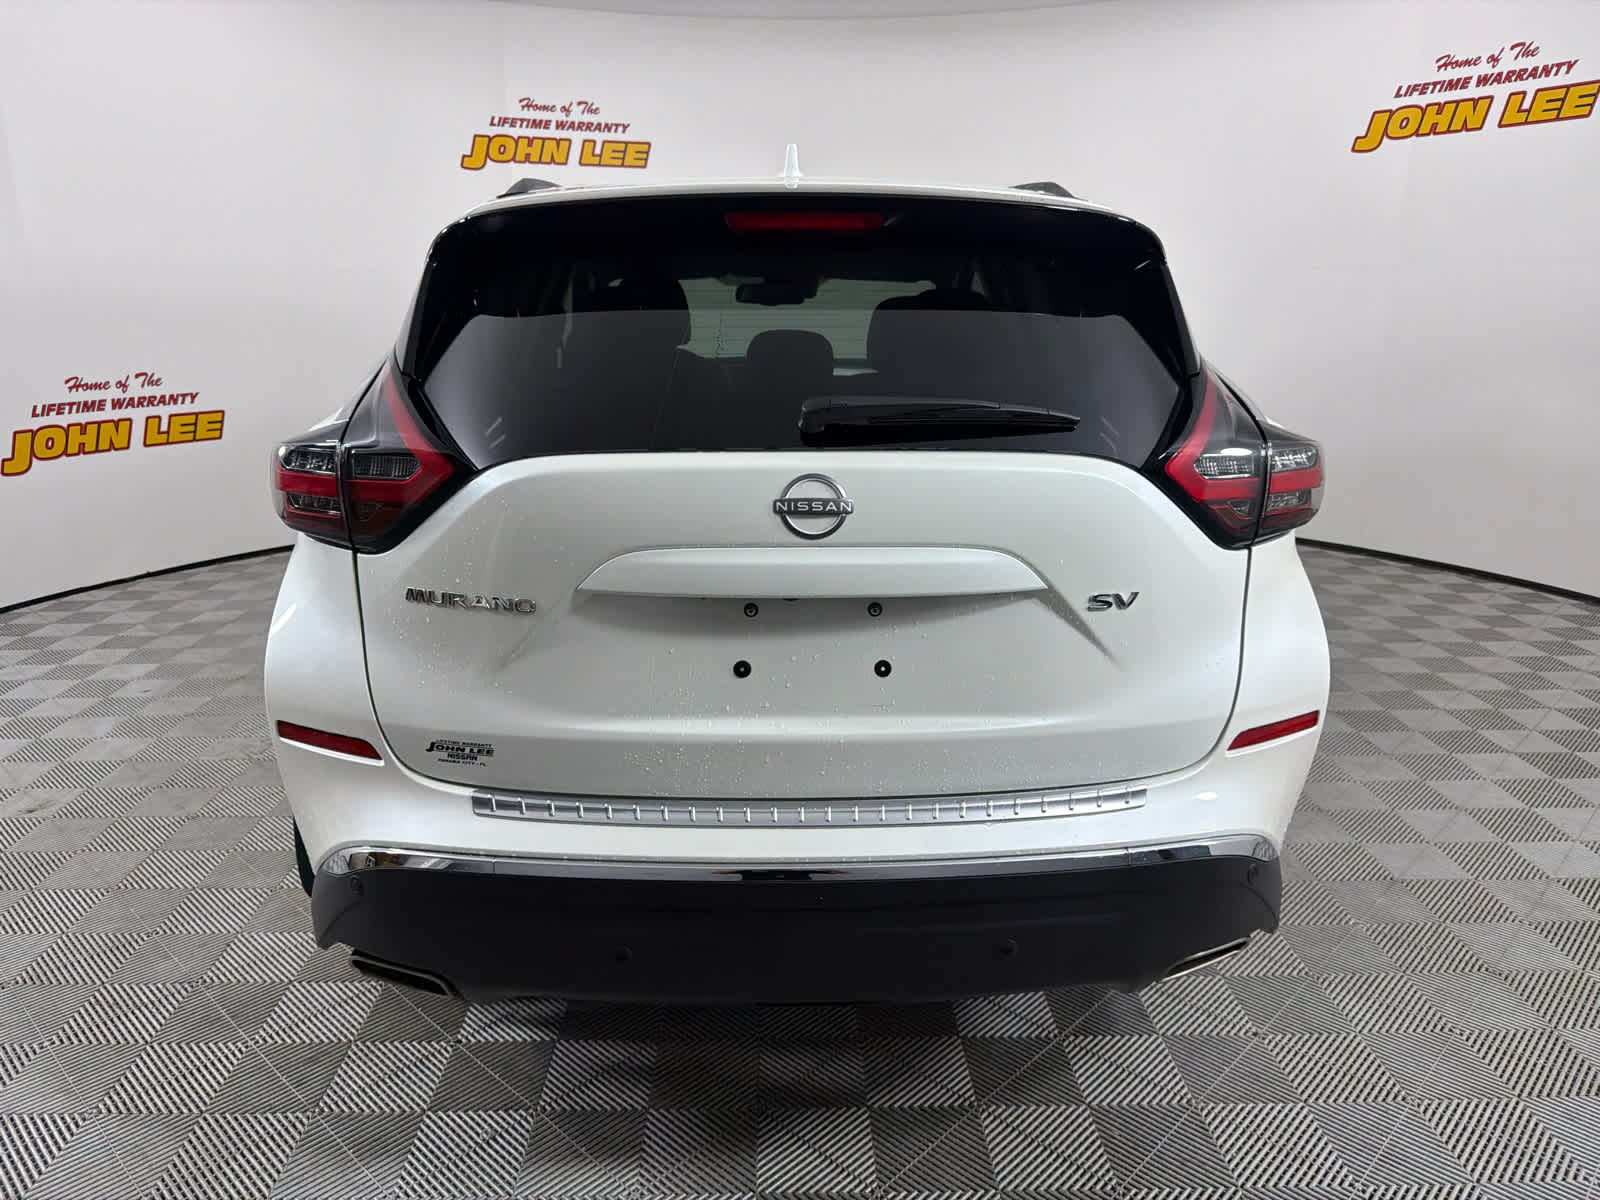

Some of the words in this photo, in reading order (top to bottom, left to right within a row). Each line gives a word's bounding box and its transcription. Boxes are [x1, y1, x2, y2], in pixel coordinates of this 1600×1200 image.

[1435, 54, 1481, 72] Home
[1486, 48, 1504, 69] of
[1510, 41, 1540, 60] The
[1393, 76, 1473, 98] LIFETIME
[1475, 59, 1580, 88] WARRANTY
[518, 97, 556, 113] Home
[560, 101, 573, 117] of
[577, 101, 600, 115] The
[1351, 95, 1495, 153] JOHN
[1497, 79, 1600, 128] LEE
[489, 115, 551, 130] LIFETIME
[555, 119, 631, 134] WARRANTY
[460, 134, 572, 171] JOHN
[579, 139, 651, 168] LEE
[64, 376, 110, 393] Home
[115, 374, 130, 393] of
[134, 371, 163, 388] The
[31, 398, 107, 418] LIFETIME
[111, 392, 199, 411] WARRANTY
[0, 417, 133, 477] JOHN
[143, 409, 225, 448] LEE
[775, 501, 852, 513] NISSAN
[405, 587, 537, 613] MURANO
[1087, 591, 1140, 612] SV
[425, 741, 466, 753] JOHN
[469, 747, 495, 756] LEE
[447, 753, 478, 761] NISSAN
